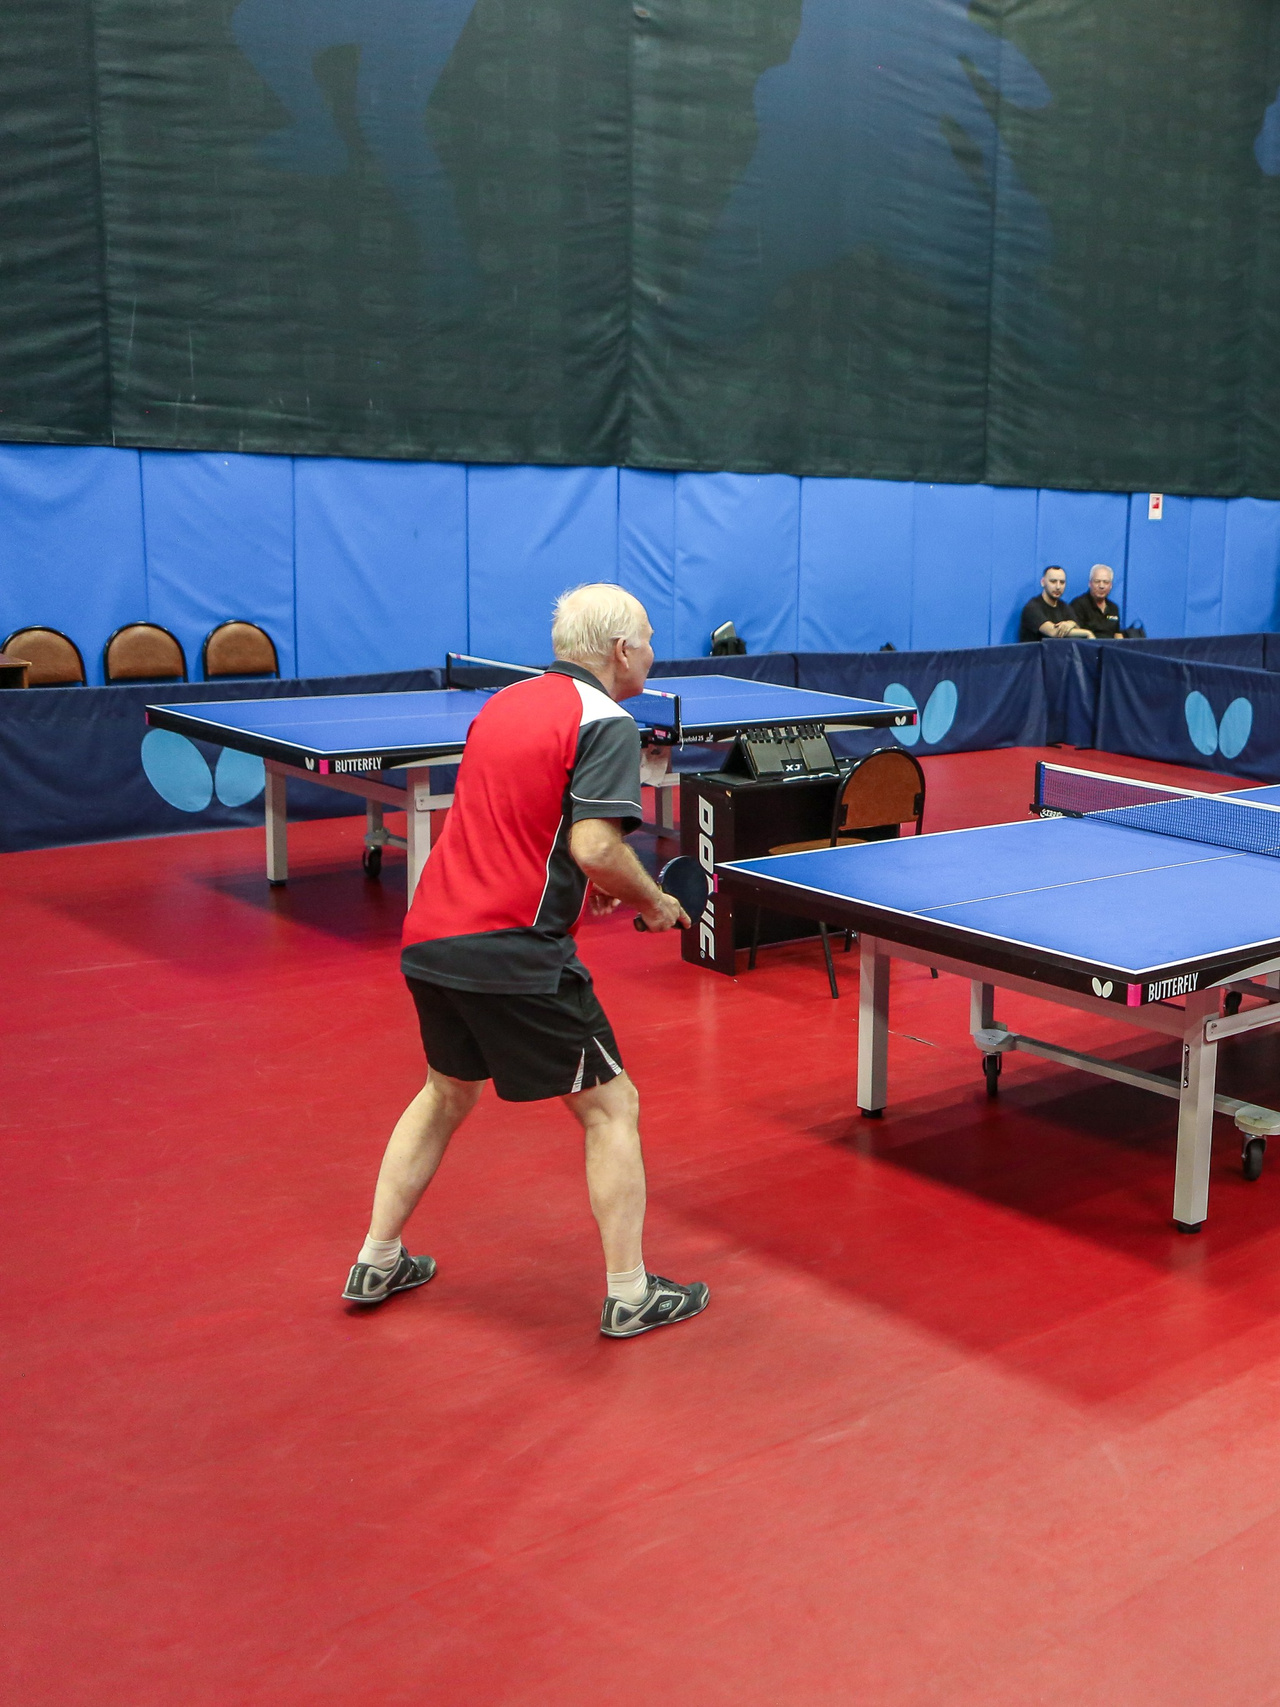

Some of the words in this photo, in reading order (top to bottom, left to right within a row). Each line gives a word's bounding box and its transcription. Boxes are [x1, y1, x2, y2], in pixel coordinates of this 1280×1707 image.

[335, 757, 382, 773] BUTTERFLY
[698, 794, 716, 961] DOIC
[1148, 972, 1199, 1003] BUTTERFLY
